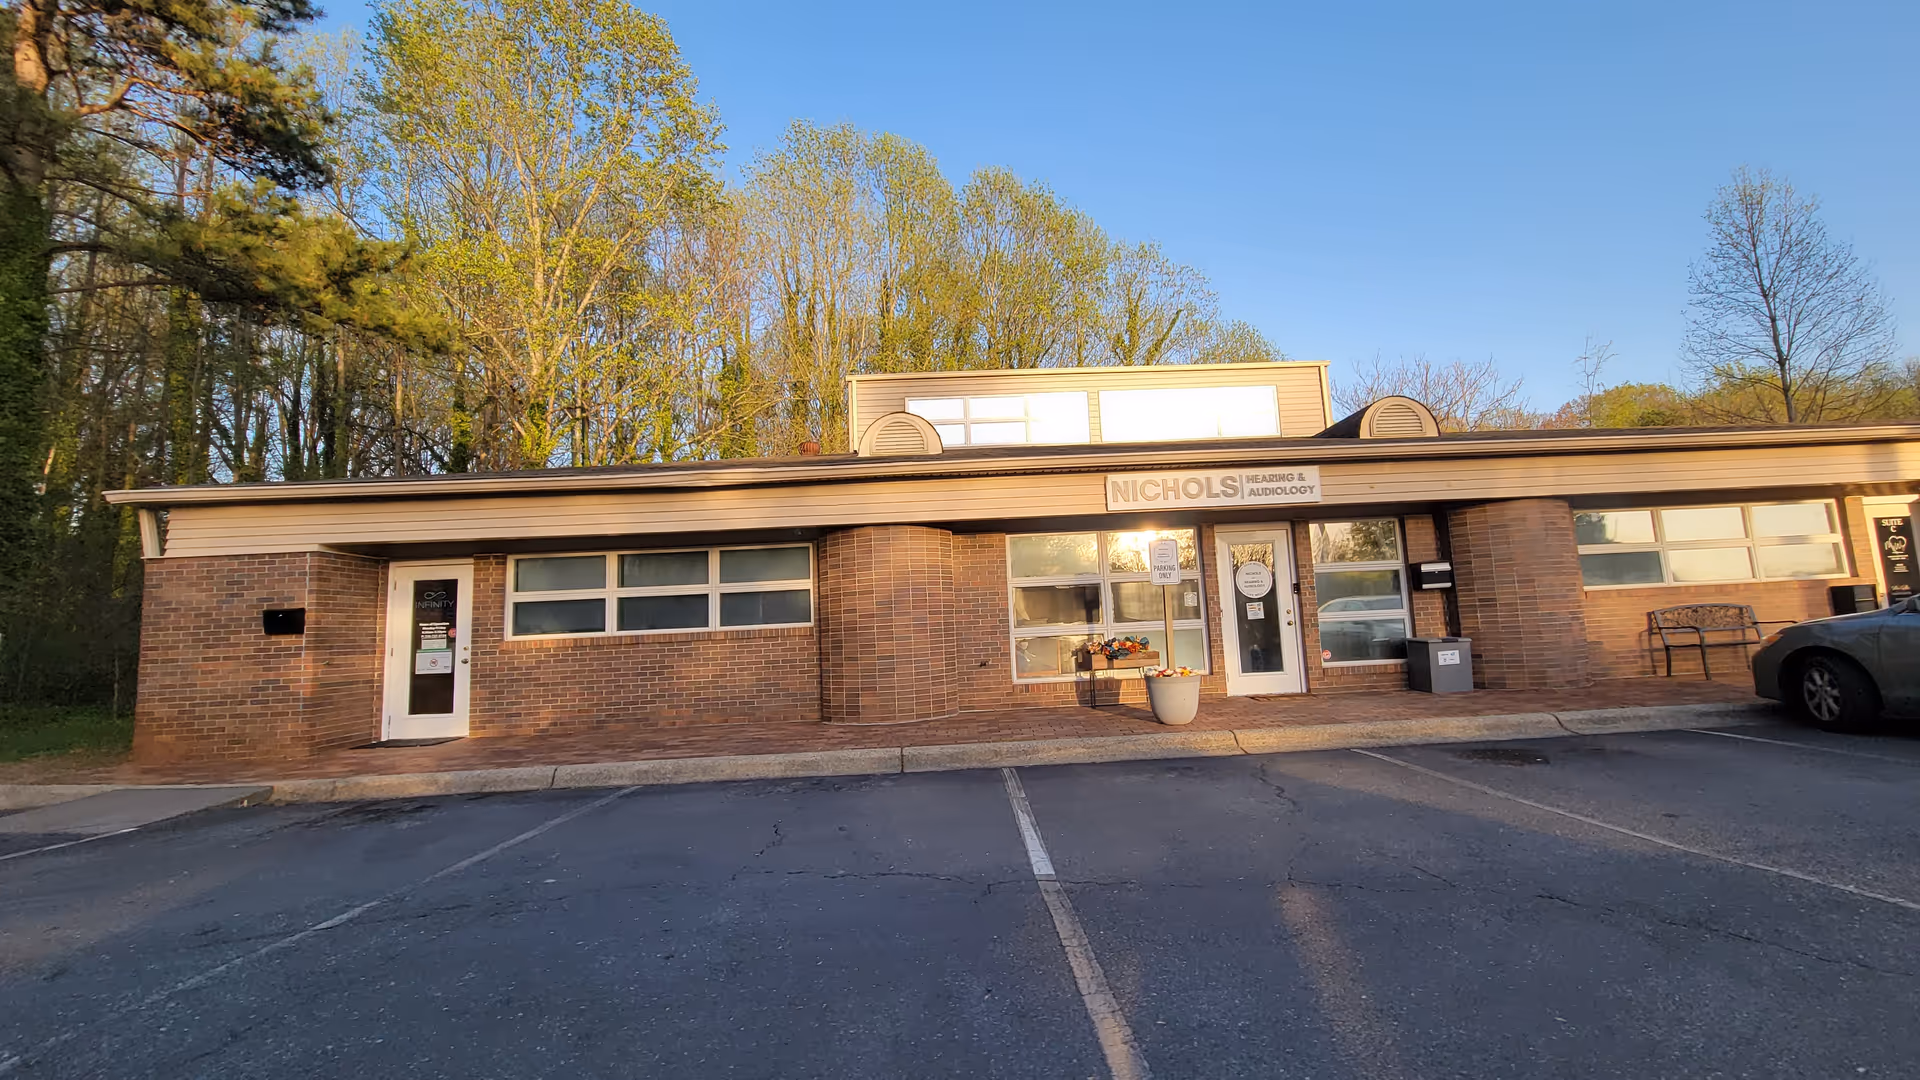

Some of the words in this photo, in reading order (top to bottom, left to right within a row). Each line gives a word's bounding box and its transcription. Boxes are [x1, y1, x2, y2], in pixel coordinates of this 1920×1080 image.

[1245, 472, 1295, 484] HEARING
[1298, 473, 1306, 482] &
[1112, 476, 1239, 502] NICHOLS
[1248, 485, 1316, 497] AUDIOLOGY
[416, 600, 454, 609] INFINITY
